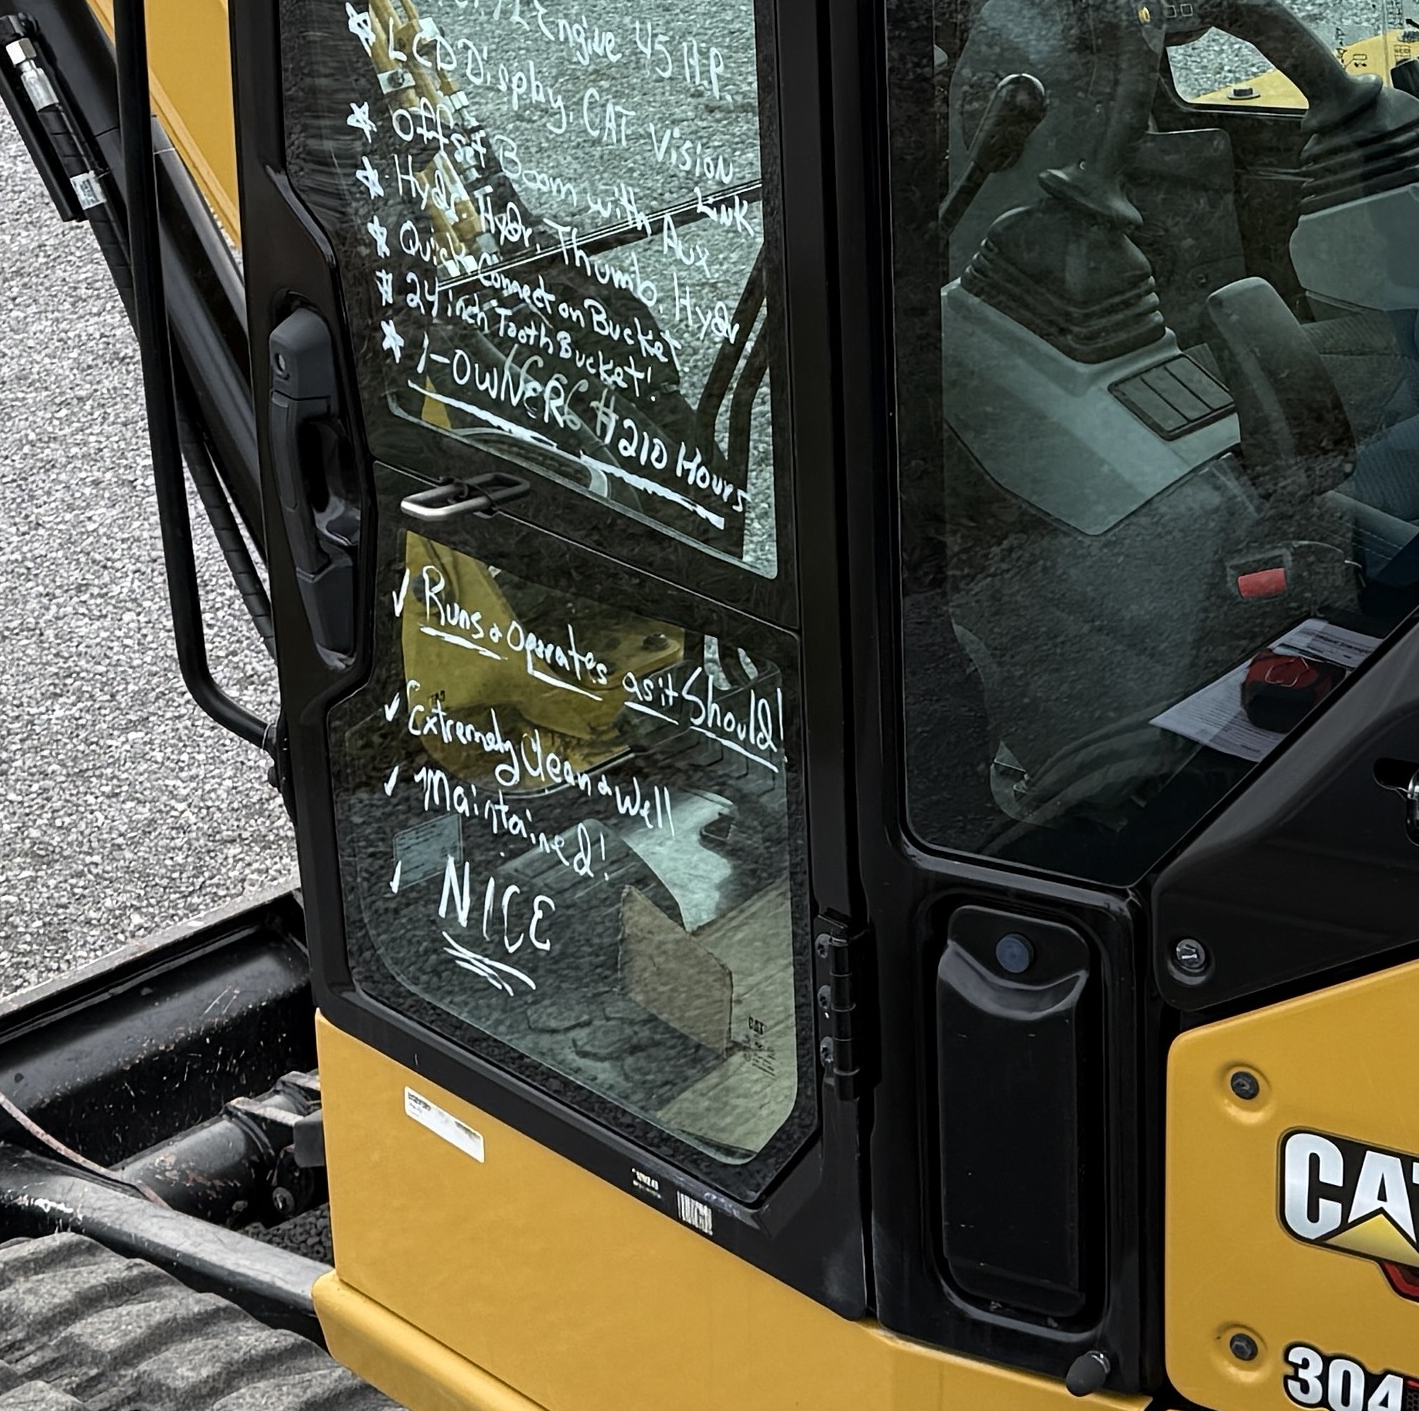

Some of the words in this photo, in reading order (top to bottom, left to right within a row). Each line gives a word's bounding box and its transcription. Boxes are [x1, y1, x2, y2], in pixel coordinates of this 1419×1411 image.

[582, 87, 637, 148] CAT
[493, 134, 577, 208] Boom
[422, 565, 484, 640] Runs
[438, 853, 558, 953] NICE
